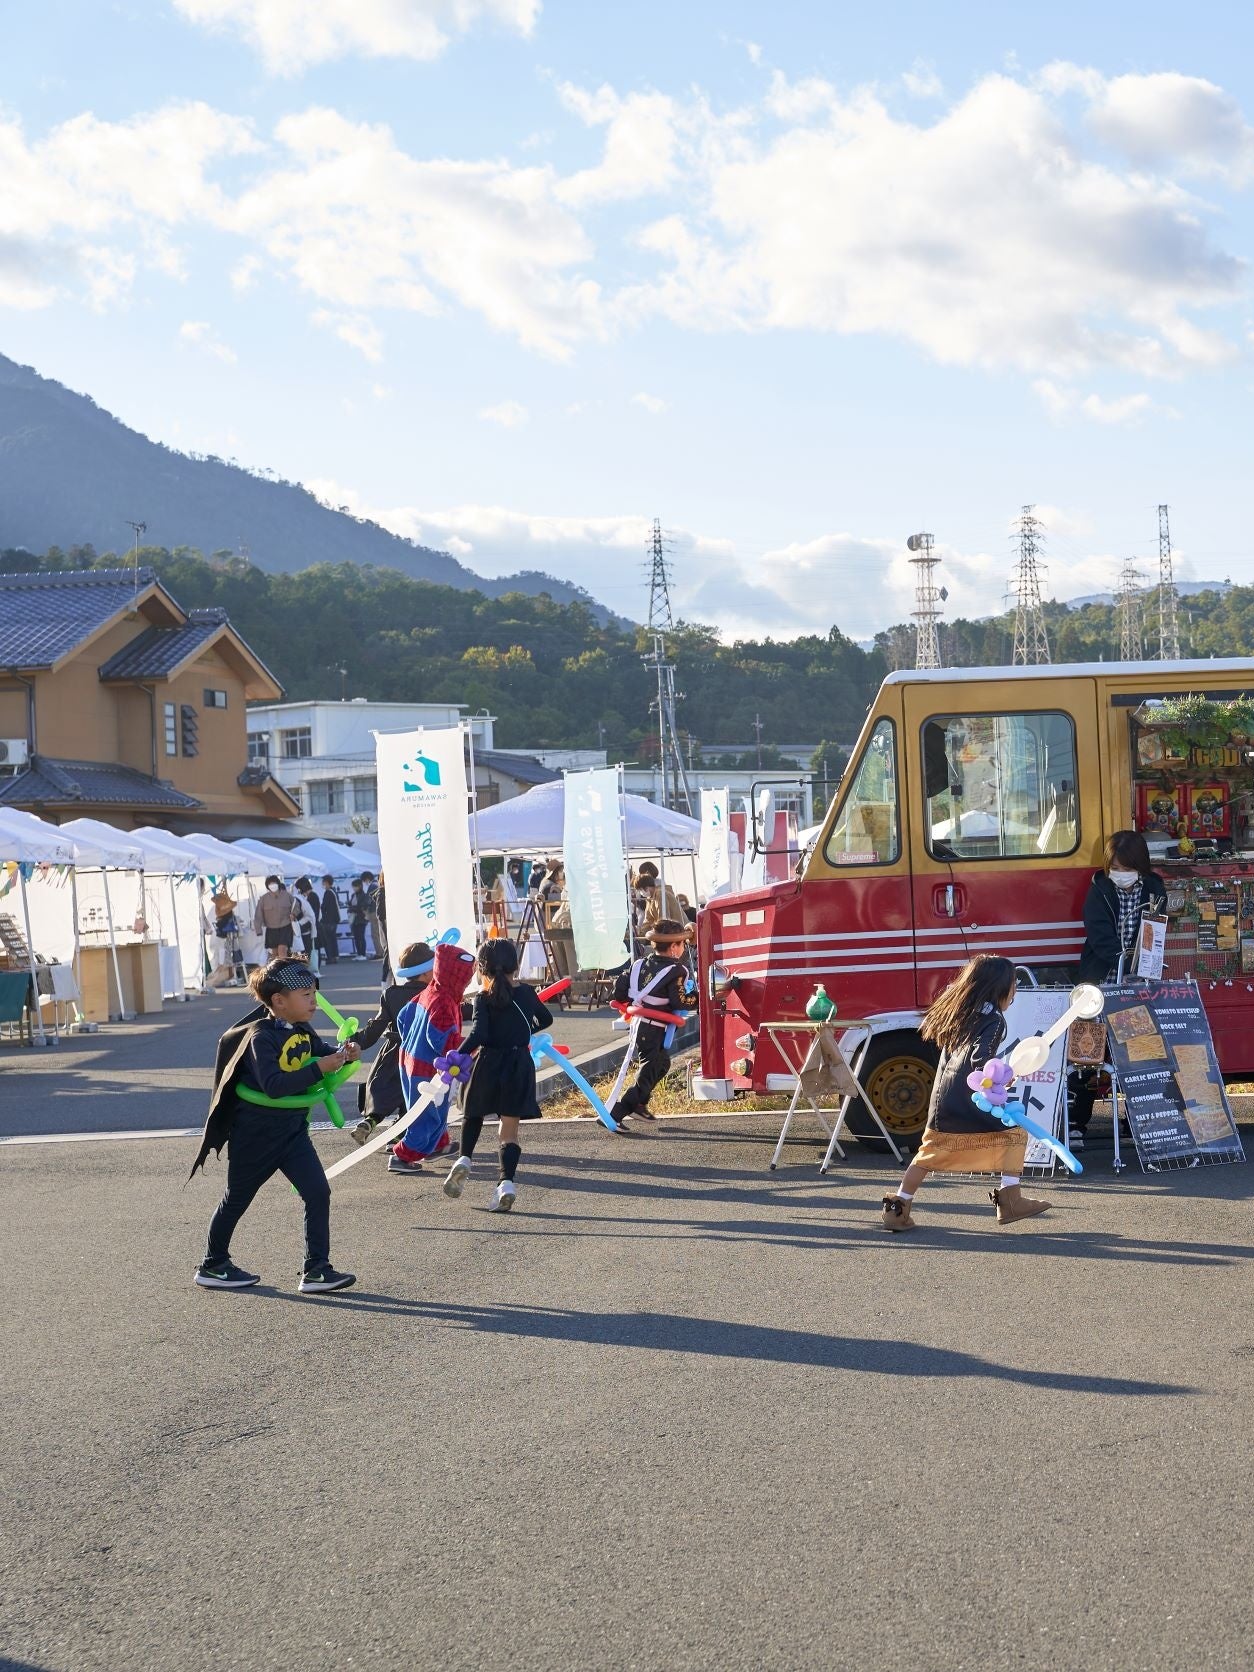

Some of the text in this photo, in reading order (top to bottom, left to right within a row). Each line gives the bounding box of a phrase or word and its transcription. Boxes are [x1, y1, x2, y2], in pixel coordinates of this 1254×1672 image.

[841, 853, 876, 862] Supreme
[1103, 989, 1120, 997] RENCH
[1139, 986, 1196, 1001] ロングポテト
[1019, 1071, 1056, 1084] RIES
[1124, 1070, 1171, 1083] GARLIC BUTTER
